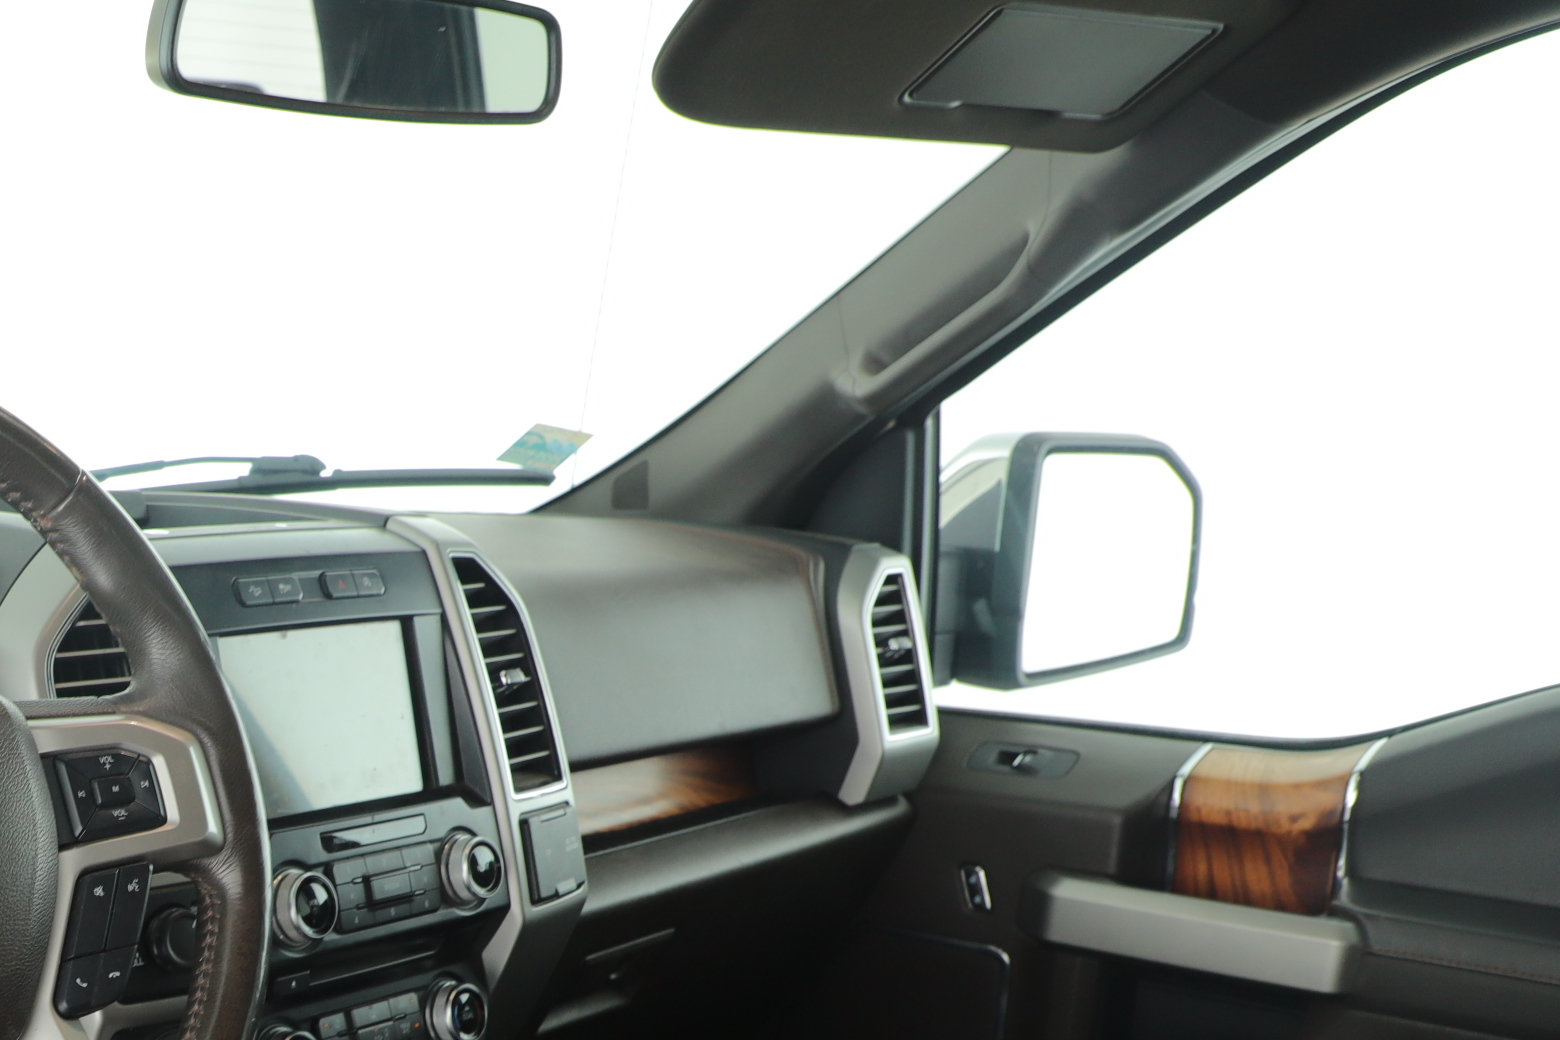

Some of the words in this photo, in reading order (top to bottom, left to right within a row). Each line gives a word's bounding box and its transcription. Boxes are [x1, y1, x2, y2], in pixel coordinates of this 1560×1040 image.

[99, 755, 115, 764] VOL
[111, 784, 120, 793] M
[111, 808, 128, 818] VOL
